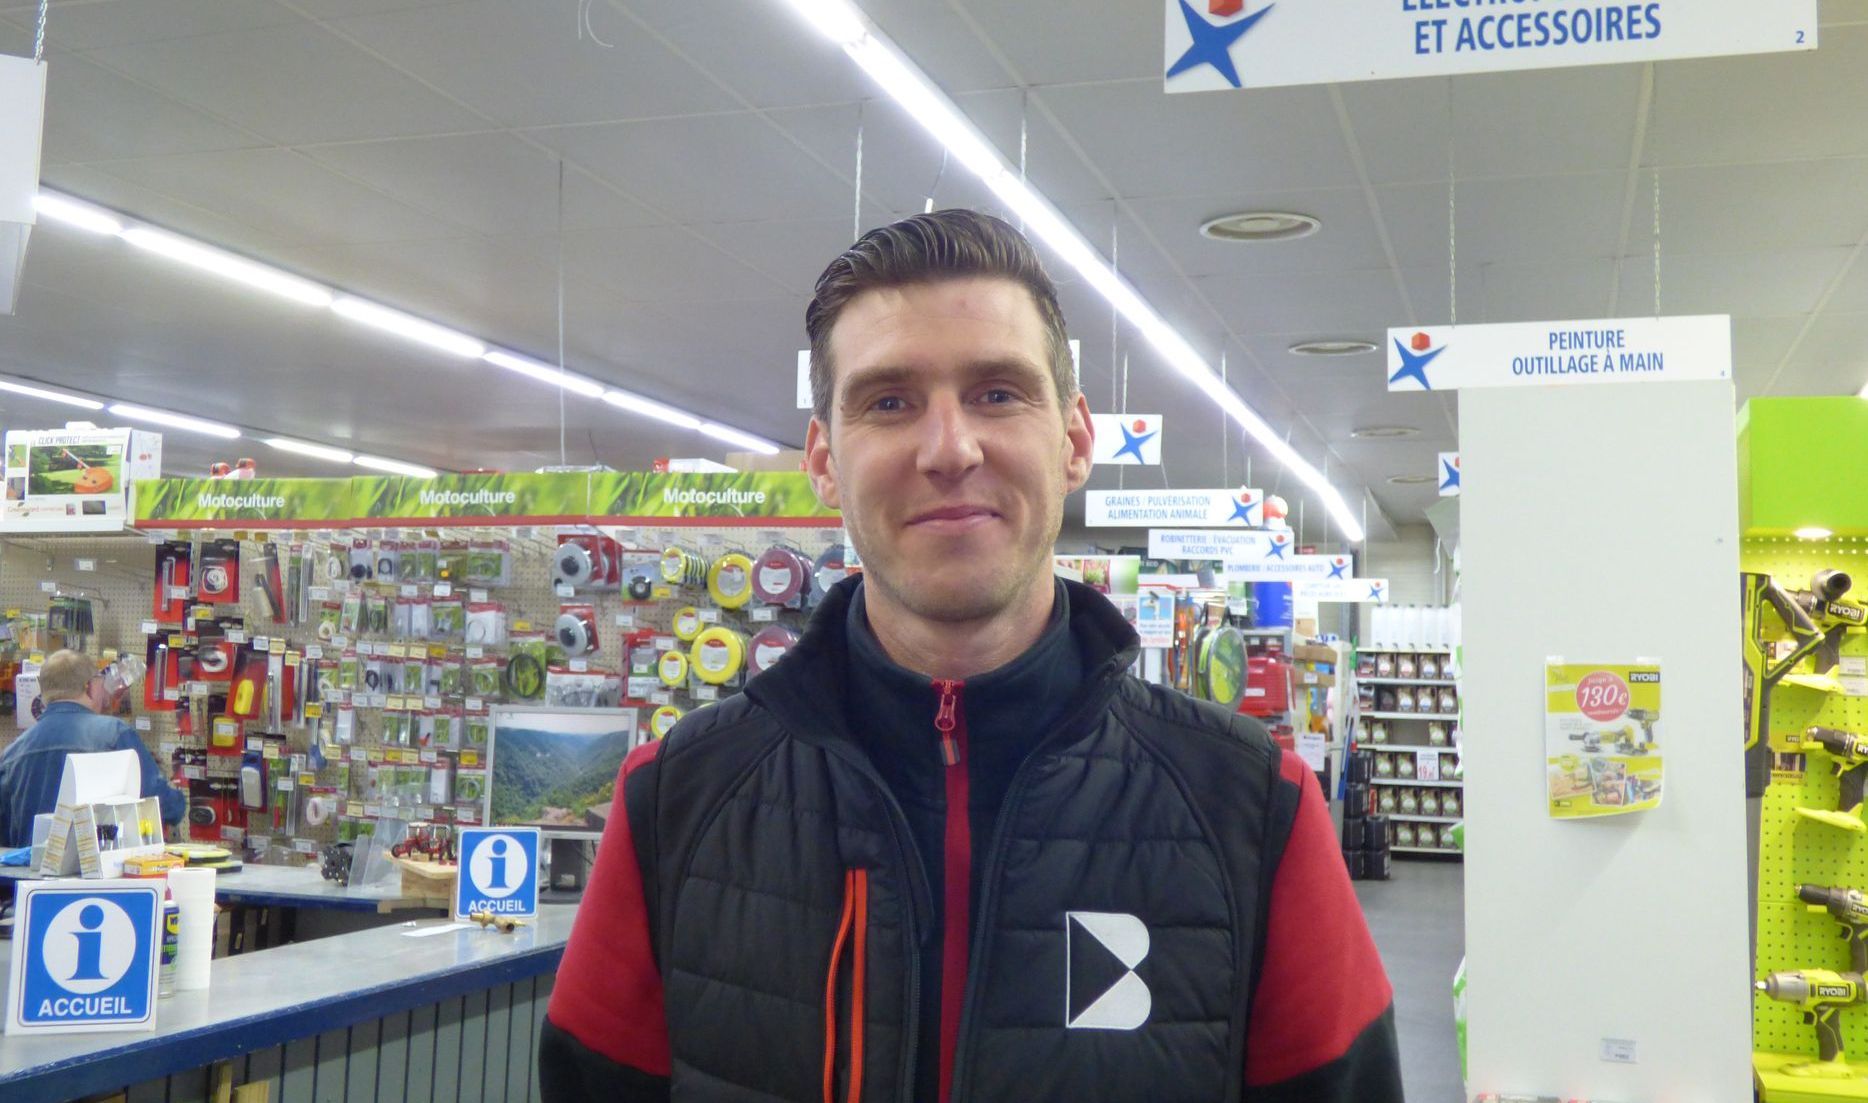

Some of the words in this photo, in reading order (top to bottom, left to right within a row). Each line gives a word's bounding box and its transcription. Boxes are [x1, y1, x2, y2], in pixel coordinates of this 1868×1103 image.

[1415, 19, 1447, 54] ET
[1455, 3, 1662, 52] ACCESSOIRES
[1795, 30, 1805, 44] 2
[1549, 330, 1625, 350] PEINTURE
[1512, 354, 1598, 376] OUTILLAGE
[1603, 349, 1614, 372] À
[1620, 353, 1664, 372] MAIN
[198, 494, 285, 508] Motoculture
[420, 489, 515, 505] Motoculture
[664, 488, 766, 503] Motoculture
[1105, 496, 1140, 507] GRAINES
[1108, 509, 1168, 520] ALIMENTATION
[1170, 509, 1207, 520] ANIMALE
[1829, 603, 1861, 619] RYOBI
[1629, 673, 1659, 682] RYOBI
[468, 900, 526, 912] ACCUEIL
[1819, 986, 1847, 997] RYOBI
[38, 996, 132, 1017] ACCUEIL
